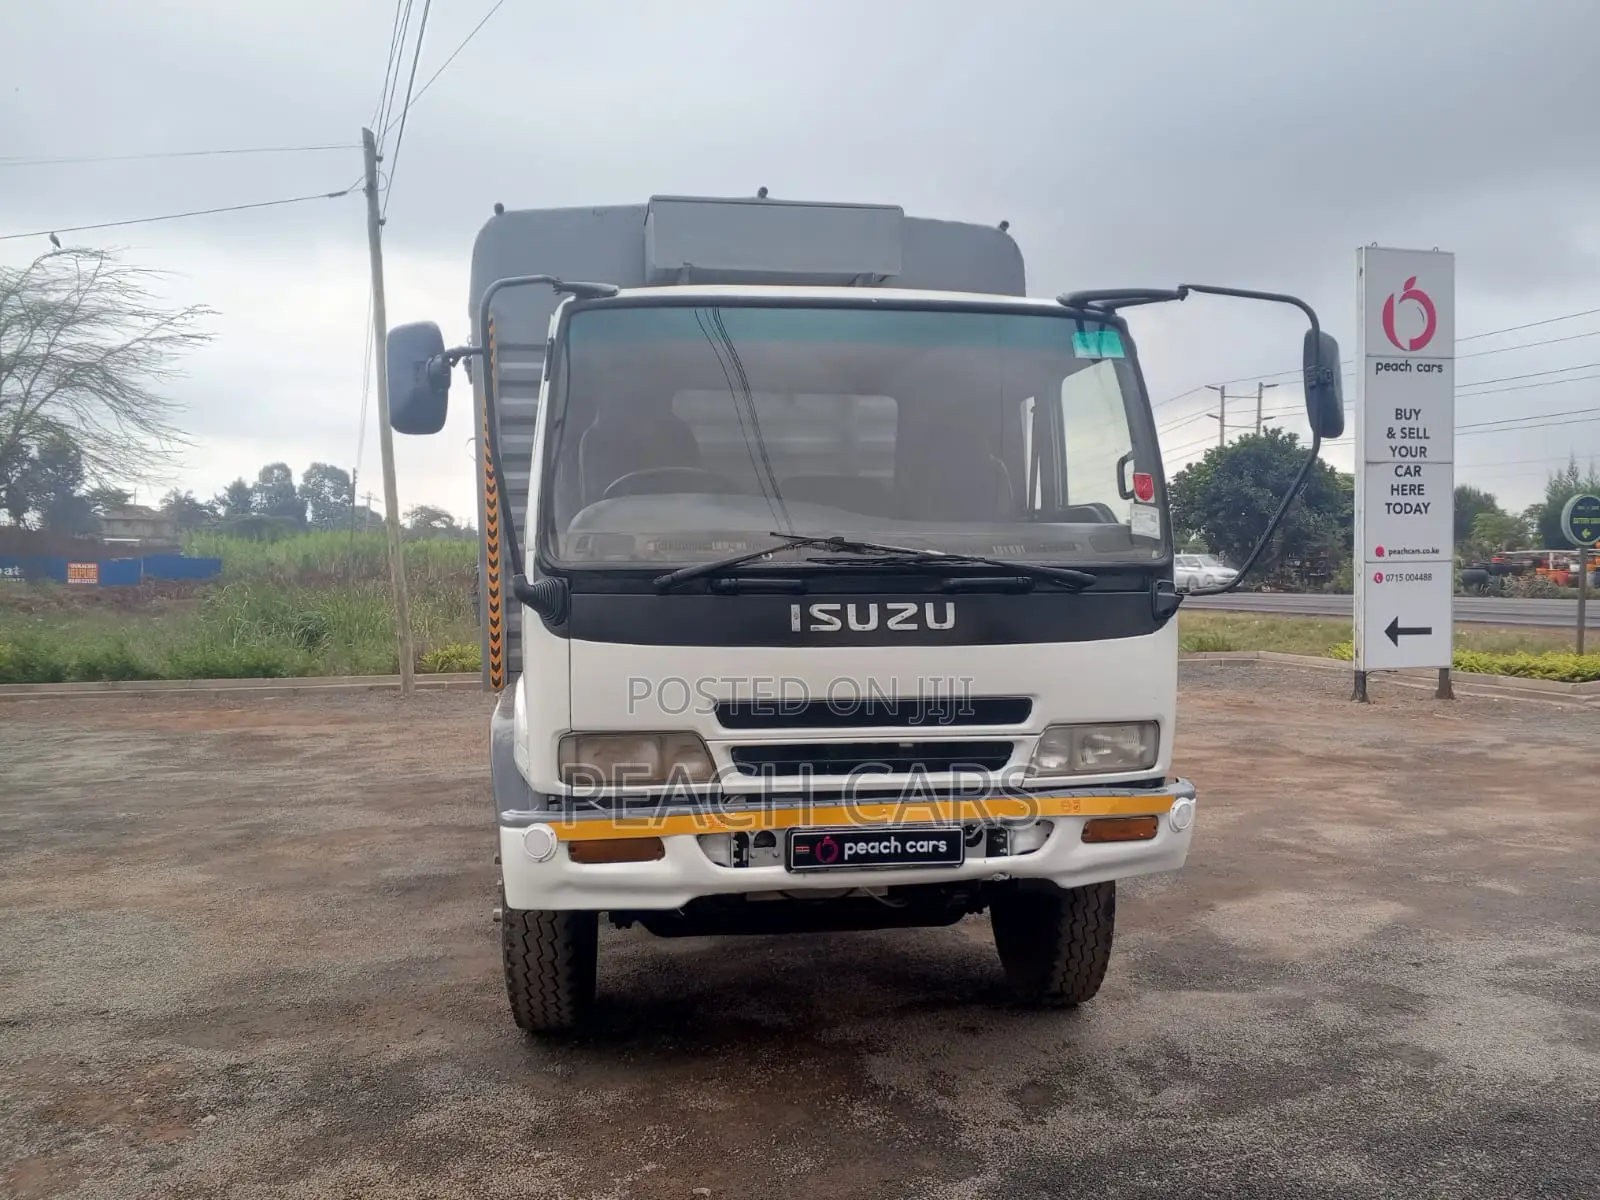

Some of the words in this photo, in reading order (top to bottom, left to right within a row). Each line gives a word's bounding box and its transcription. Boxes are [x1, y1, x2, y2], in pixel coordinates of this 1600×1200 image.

[1375, 360, 1412, 375] peach
[1416, 362, 1444, 374] cars
[1394, 408, 1422, 421] BUY
[1386, 428, 1397, 439] &
[1400, 427, 1431, 440] SELL
[1389, 446, 1428, 458] YOUR
[1394, 465, 1422, 477] CAR
[1390, 484, 1425, 496] HERE
[1385, 502, 1431, 515] TODAY
[1385, 573, 1404, 582] 0715
[790, 602, 956, 633] ISUZU
[844, 836, 901, 860] peach
[905, 840, 948, 854] cars
